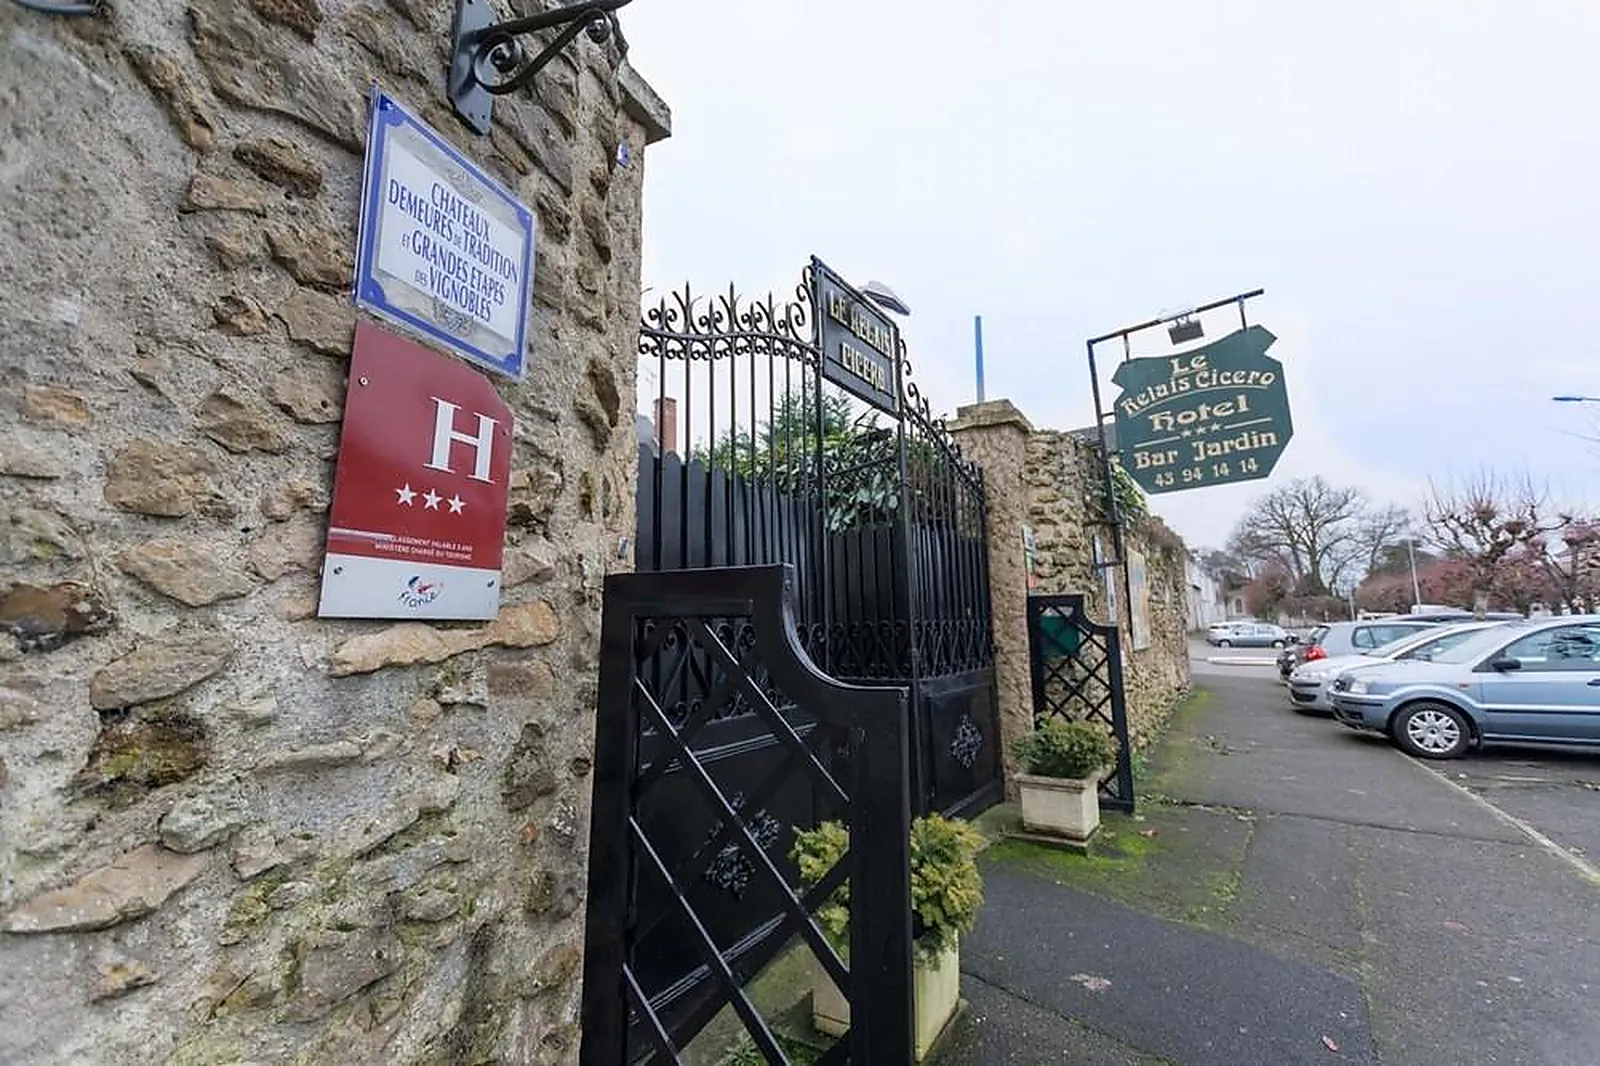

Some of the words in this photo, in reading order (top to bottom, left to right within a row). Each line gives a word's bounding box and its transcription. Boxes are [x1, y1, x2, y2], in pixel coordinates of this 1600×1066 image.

[388, 178, 453, 243] DEMEURES
[463, 229, 519, 284] TRADITION
[431, 182, 489, 242] CHATEAUX
[412, 230, 469, 283] GRANDES
[470, 266, 505, 306] ETAPES
[429, 266, 491, 322] VIGNOBLES
[1170, 354, 1208, 374] Le
[1195, 368, 1276, 388] Cicero
[423, 396, 500, 484] H
[1134, 449, 1178, 469] Bar
[1192, 430, 1278, 462] Jardin
[1212, 462, 1230, 478] 14
[1240, 457, 1259, 473] 14
